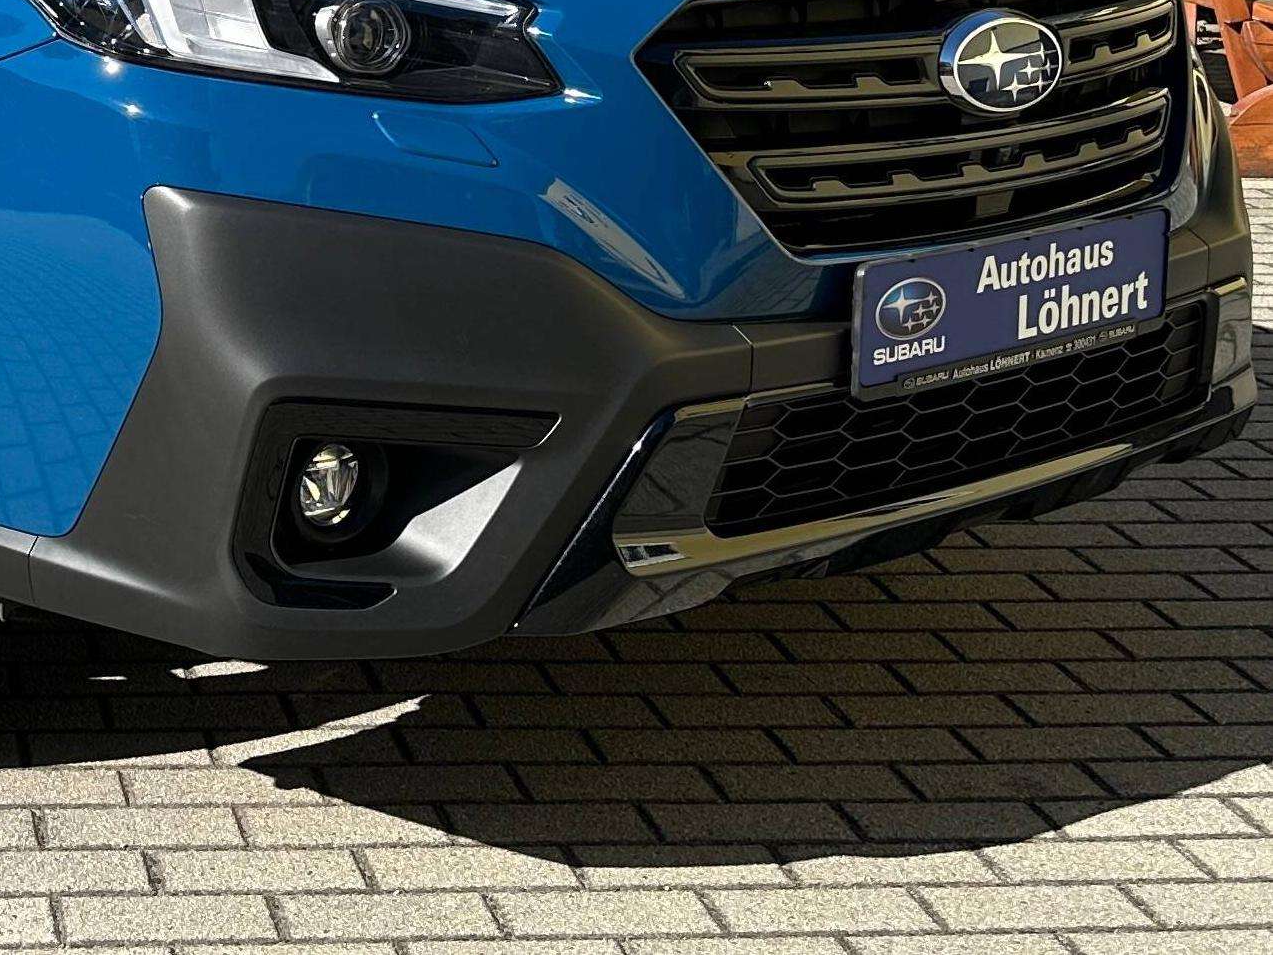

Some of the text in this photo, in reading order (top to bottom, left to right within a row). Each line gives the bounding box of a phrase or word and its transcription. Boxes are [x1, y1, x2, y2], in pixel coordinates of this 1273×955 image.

[976, 240, 1115, 294] Autohaus
[1017, 271, 1150, 340] Löhnert
[873, 335, 946, 366] SUBARU
